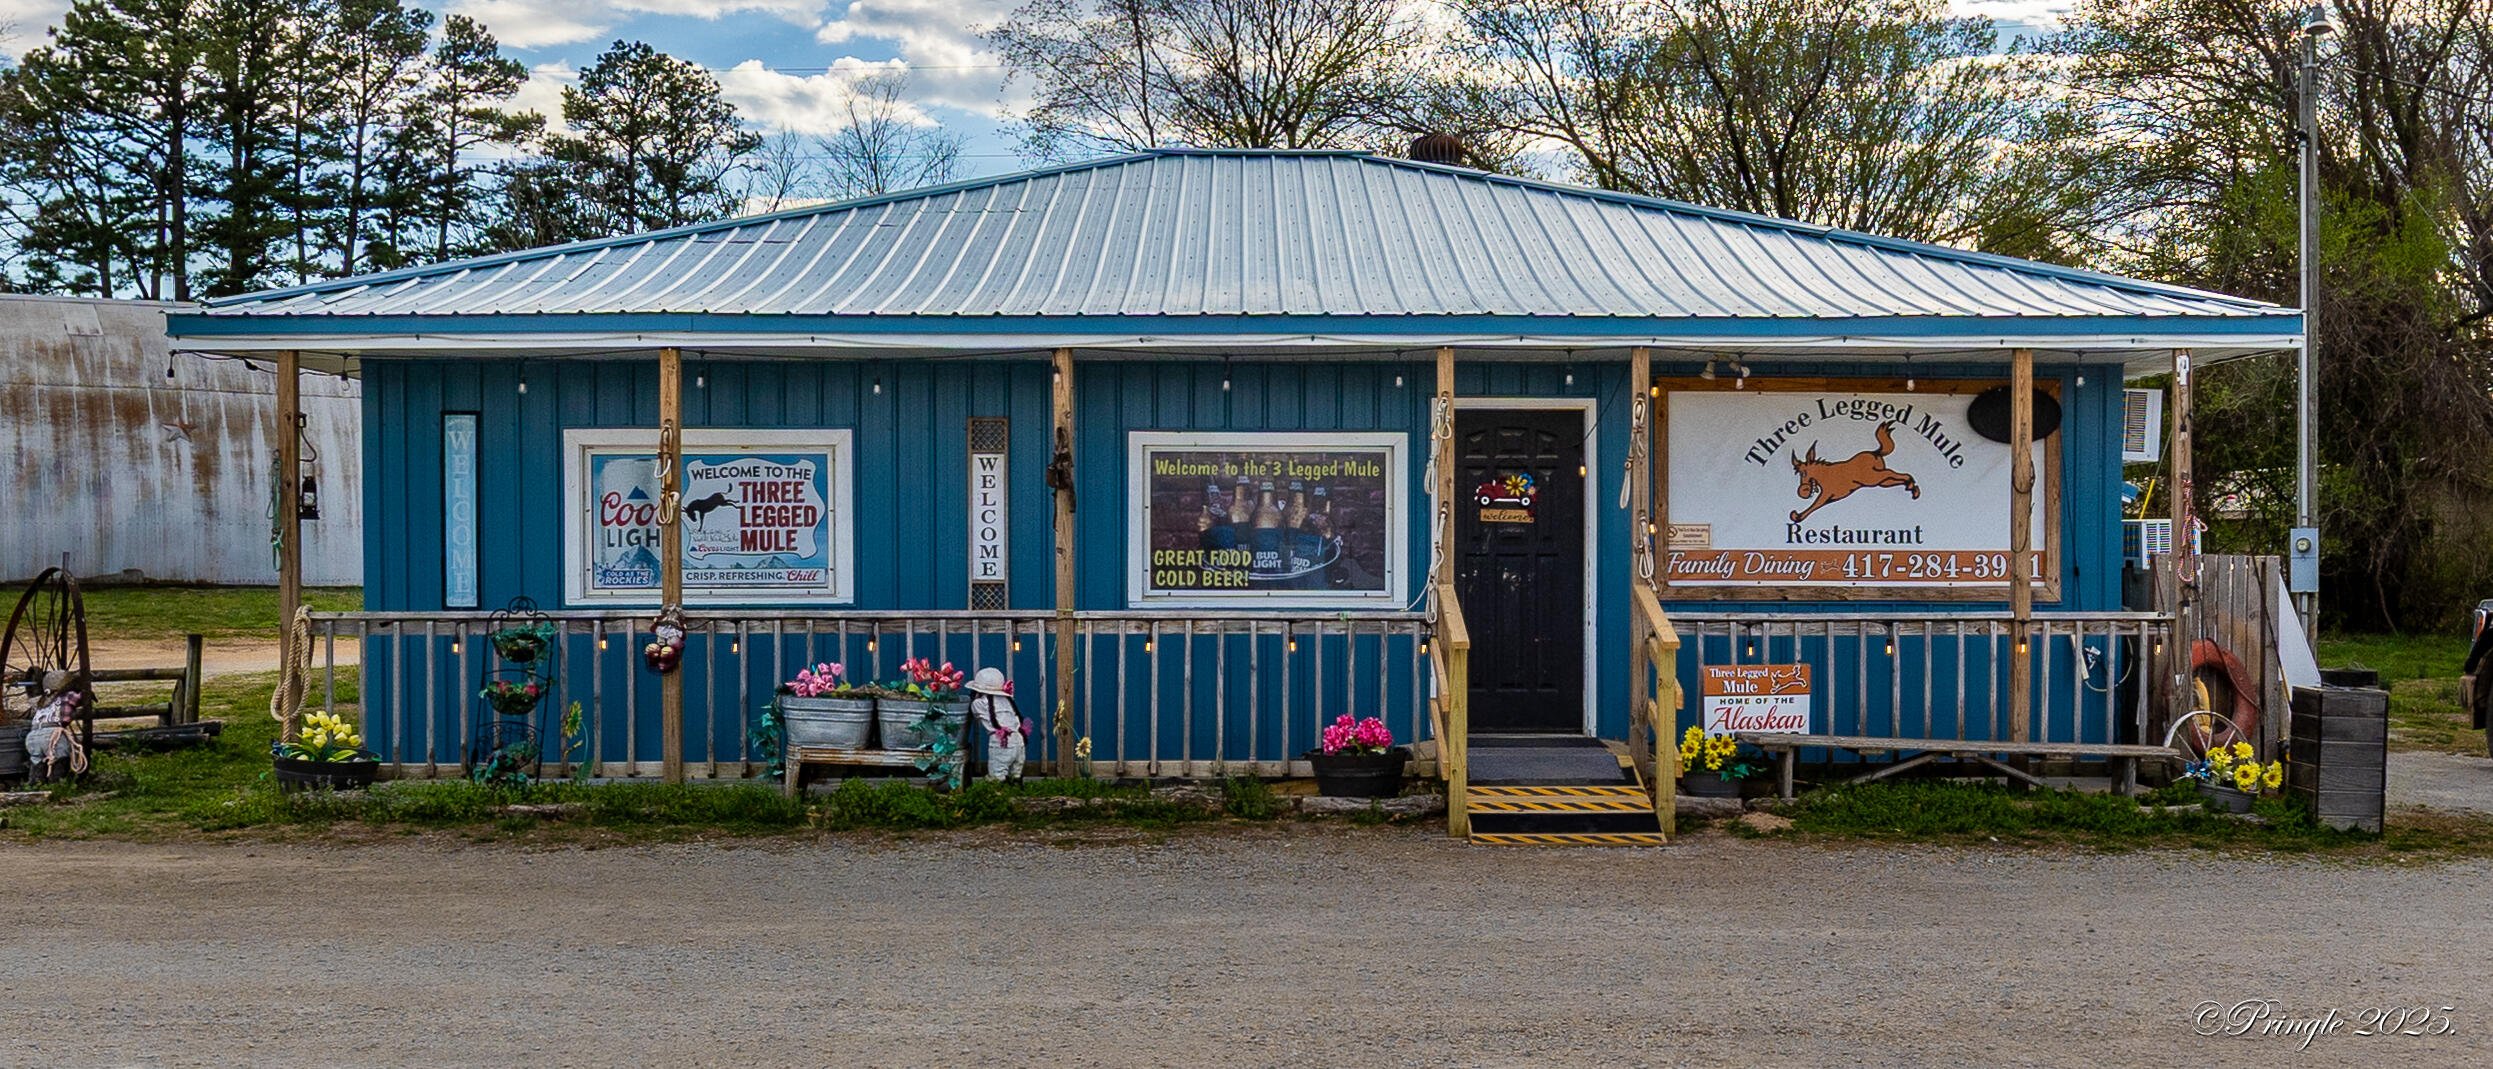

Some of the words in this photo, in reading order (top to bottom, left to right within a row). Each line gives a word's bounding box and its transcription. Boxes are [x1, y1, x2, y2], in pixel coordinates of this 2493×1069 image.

[1744, 411, 1812, 468] Three
[1815, 397, 1914, 426] Legged
[1913, 412, 1965, 470] Mule
[691, 465, 761, 481] WELCOME
[764, 466, 784, 478] TO
[785, 467, 812, 481] THE
[1155, 459, 1219, 477] Welcome
[1224, 461, 1239, 477] to
[1243, 459, 1267, 477] the
[1272, 460, 1282, 477] 3
[1288, 459, 1338, 481] Legged
[1344, 460, 1381, 478] Mule
[738, 481, 806, 504] THREE
[448, 430, 474, 593] WELCOME
[600, 491, 664, 527] Coo
[739, 505, 818, 528] LEGGED
[978, 457, 1000, 577] WELCOME
[606, 528, 660, 548] LIGH
[740, 529, 798, 552] MULE
[1786, 522, 1924, 544] Restaurant
[1153, 549, 1206, 566] GREAT
[1210, 549, 1252, 567] FOOD
[1253, 560, 1282, 569] LIGHT
[1256, 552, 1279, 560] BUD
[1668, 551, 1738, 579] Family
[1743, 551, 1816, 580] Dining
[1842, 553, 2043, 579] 417-284-391
[605, 576, 650, 585] ROCKIES
[686, 572, 717, 581] CRISP.
[719, 571, 786, 581] REFRESHING.
[786, 569, 819, 582] Chill
[1155, 570, 1197, 587] COLD
[1202, 570, 1250, 587] BEER!
[1709, 668, 1735, 678] Three
[1737, 667, 1769, 680] Legged
[1723, 680, 1759, 694] Mule
[1719, 697, 1750, 705] HOME
[1755, 697, 1769, 705] OF
[1708, 704, 1807, 732] Alaskan
